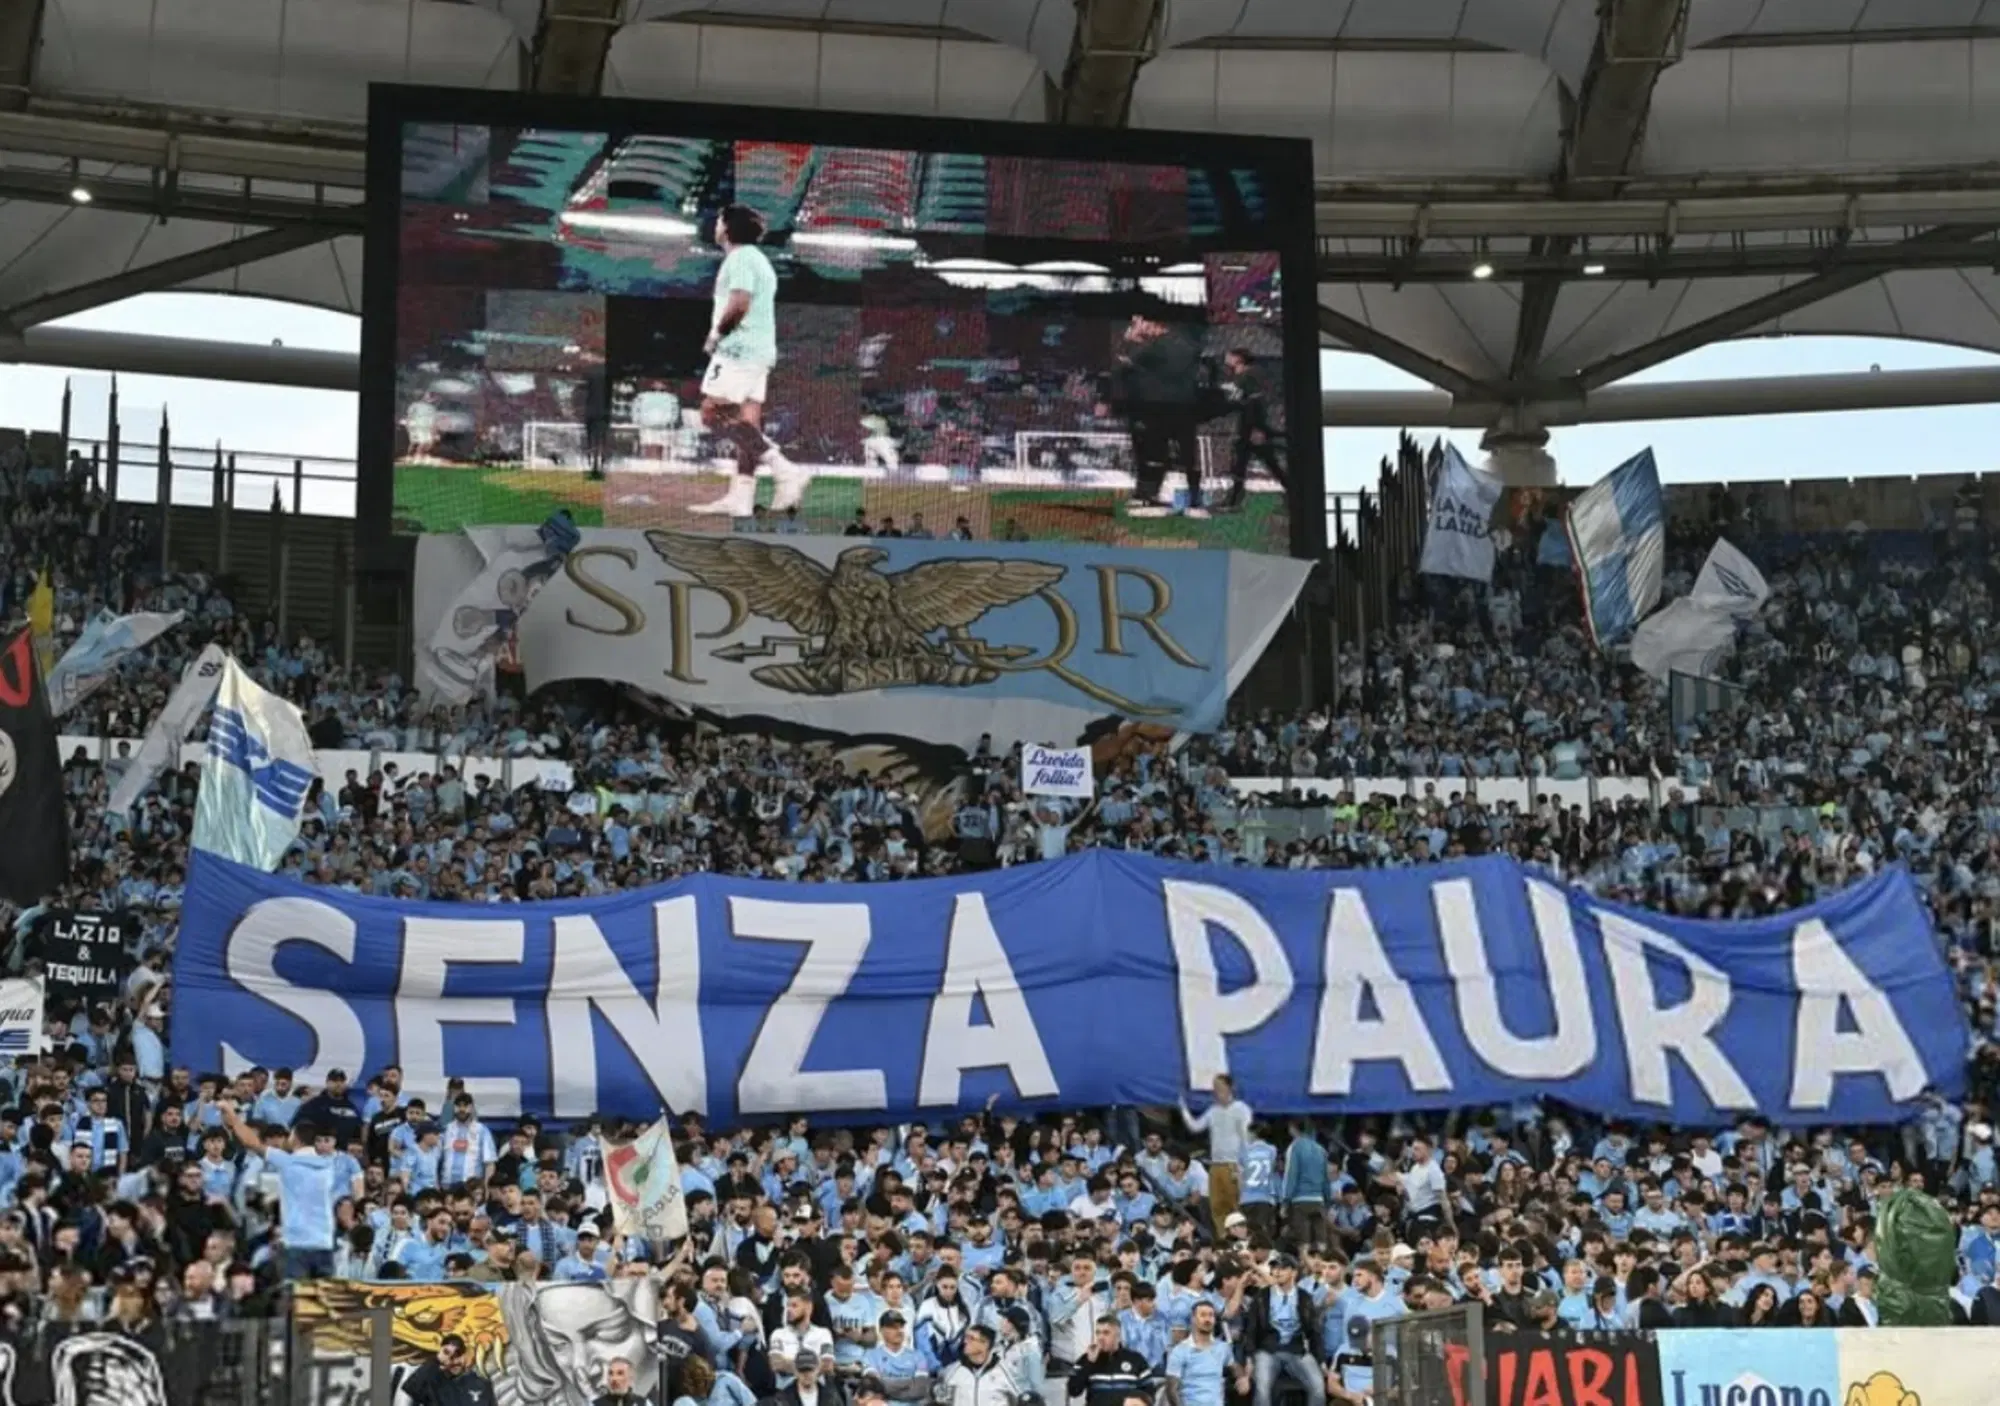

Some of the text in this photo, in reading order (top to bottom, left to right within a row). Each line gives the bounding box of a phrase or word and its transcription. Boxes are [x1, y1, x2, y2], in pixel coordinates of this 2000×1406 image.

[54, 921, 120, 944] LAZIO
[77, 945, 91, 961] &
[46, 962, 117, 986] TEQUILA
[223, 878, 1930, 1118] SENZA PAURA
